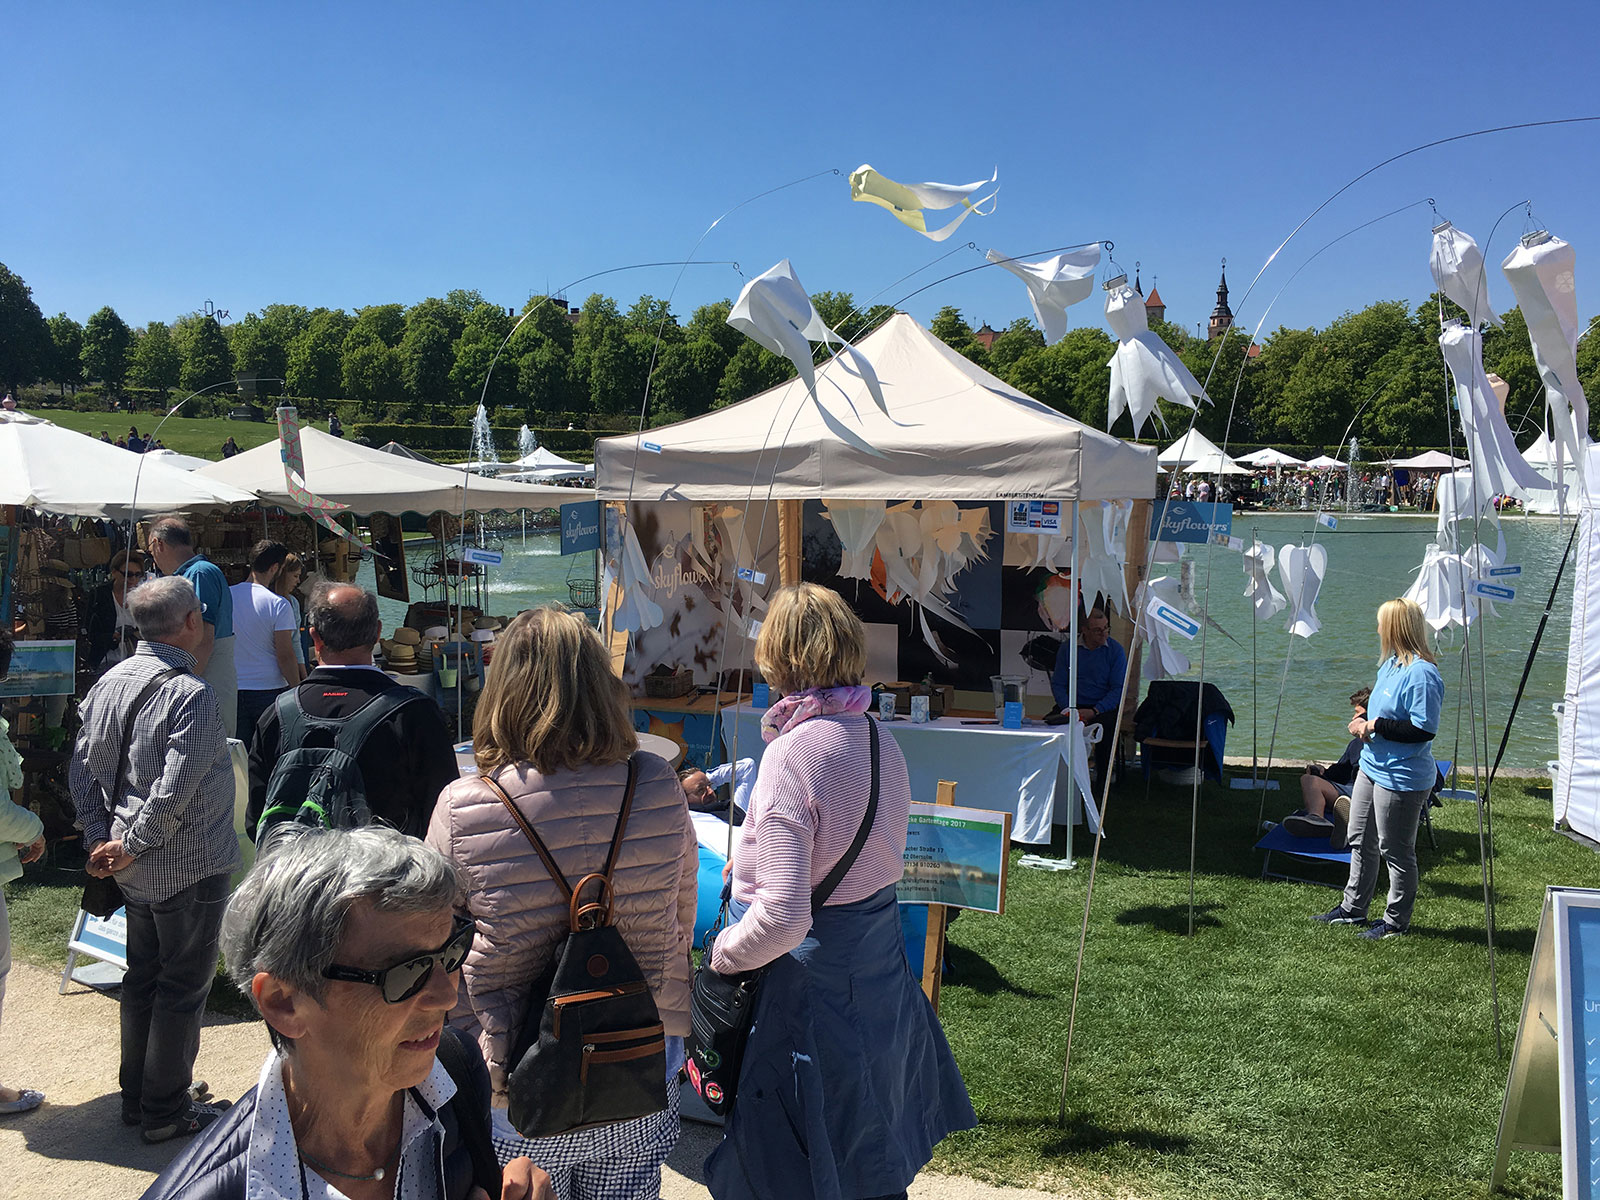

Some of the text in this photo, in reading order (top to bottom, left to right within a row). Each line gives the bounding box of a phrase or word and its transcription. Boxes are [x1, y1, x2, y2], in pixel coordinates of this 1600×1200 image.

[565, 521, 598, 544] skyflowers
[654, 562, 713, 599] skyflowe
[950, 820, 966, 828] 2017
